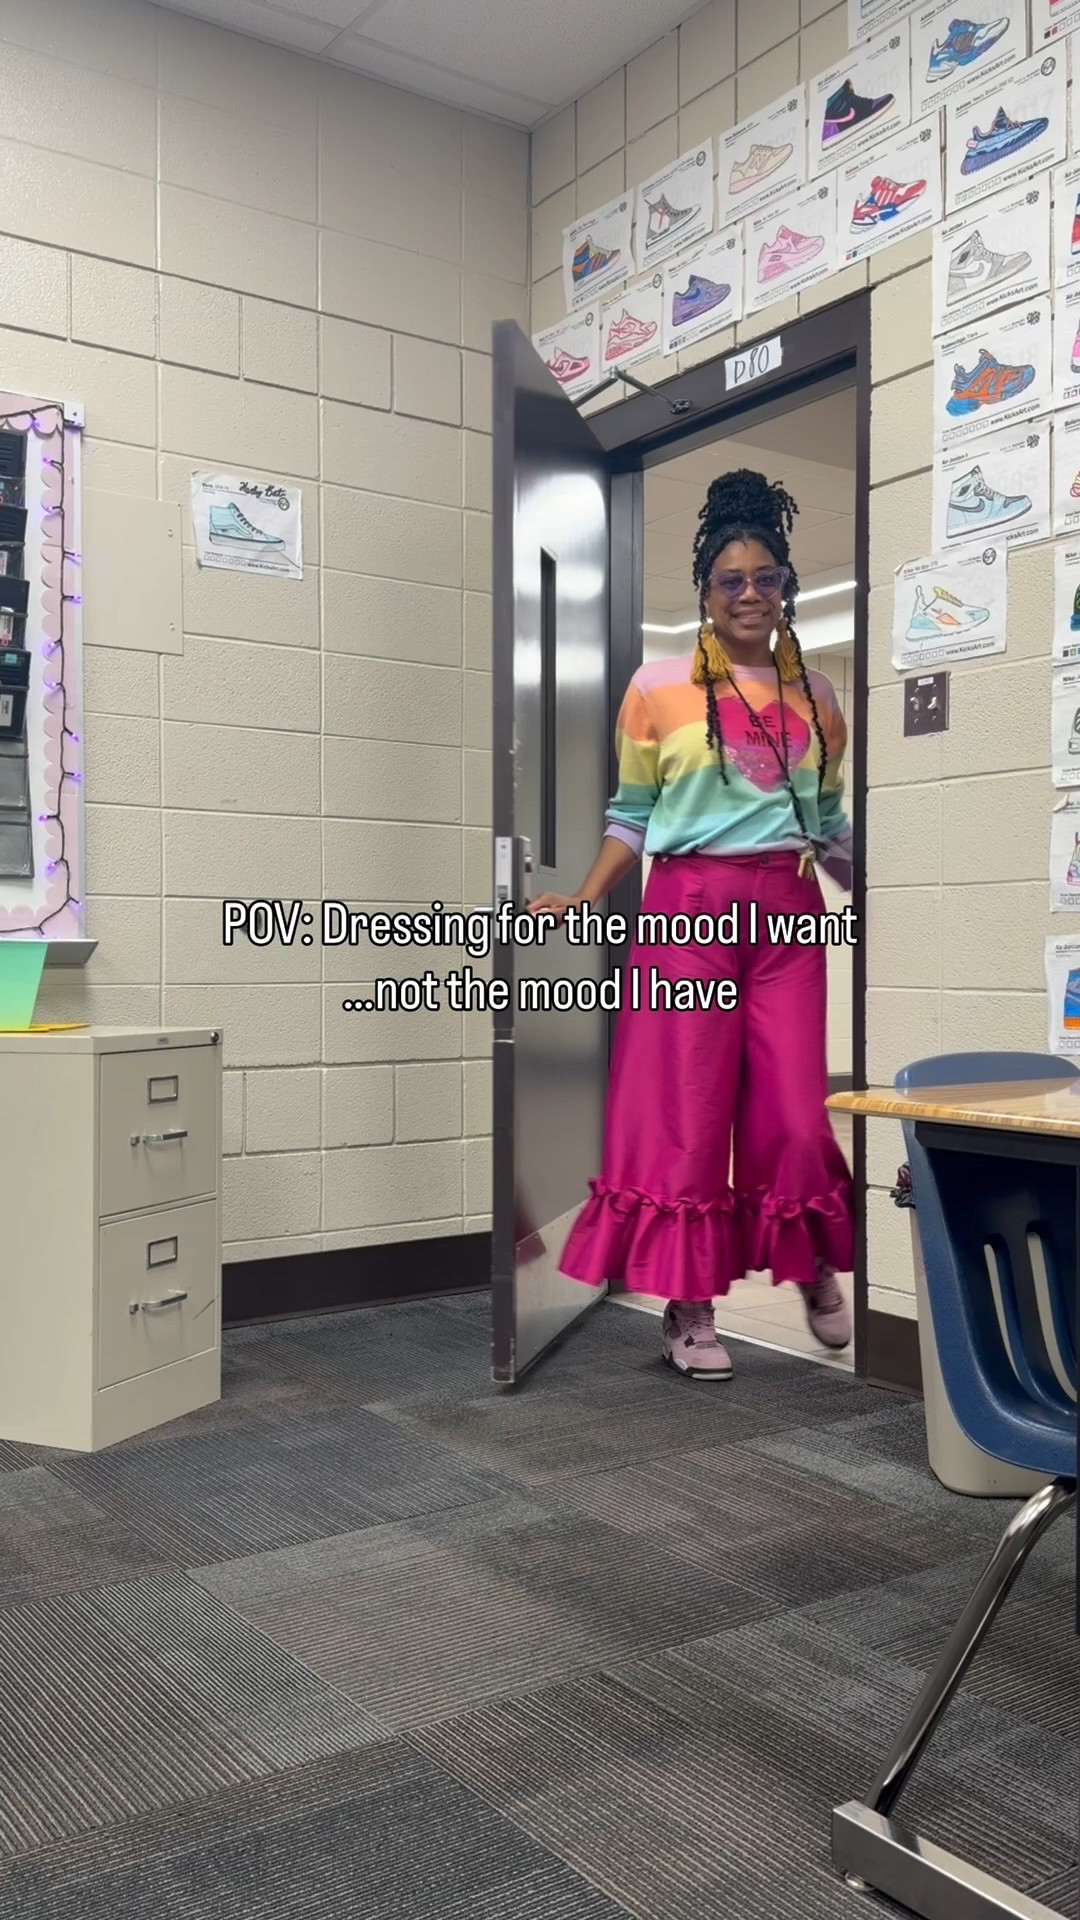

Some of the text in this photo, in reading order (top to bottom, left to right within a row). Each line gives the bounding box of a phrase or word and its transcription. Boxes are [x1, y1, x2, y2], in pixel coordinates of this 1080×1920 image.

[966, 53, 1016, 84] www.KicksArt.com
[1003, 153, 1055, 182] www.KicksArt.com
[887, 215, 933, 240] www.KicksArt.com
[986, 283, 1039, 306] www.KicksArt.com
[990, 403, 1041, 425] www.KicksArt.com
[946, 641, 995, 656] www.KicksArt.com
[748, 714, 777, 728] BE
[744, 730, 793, 748] MINE
